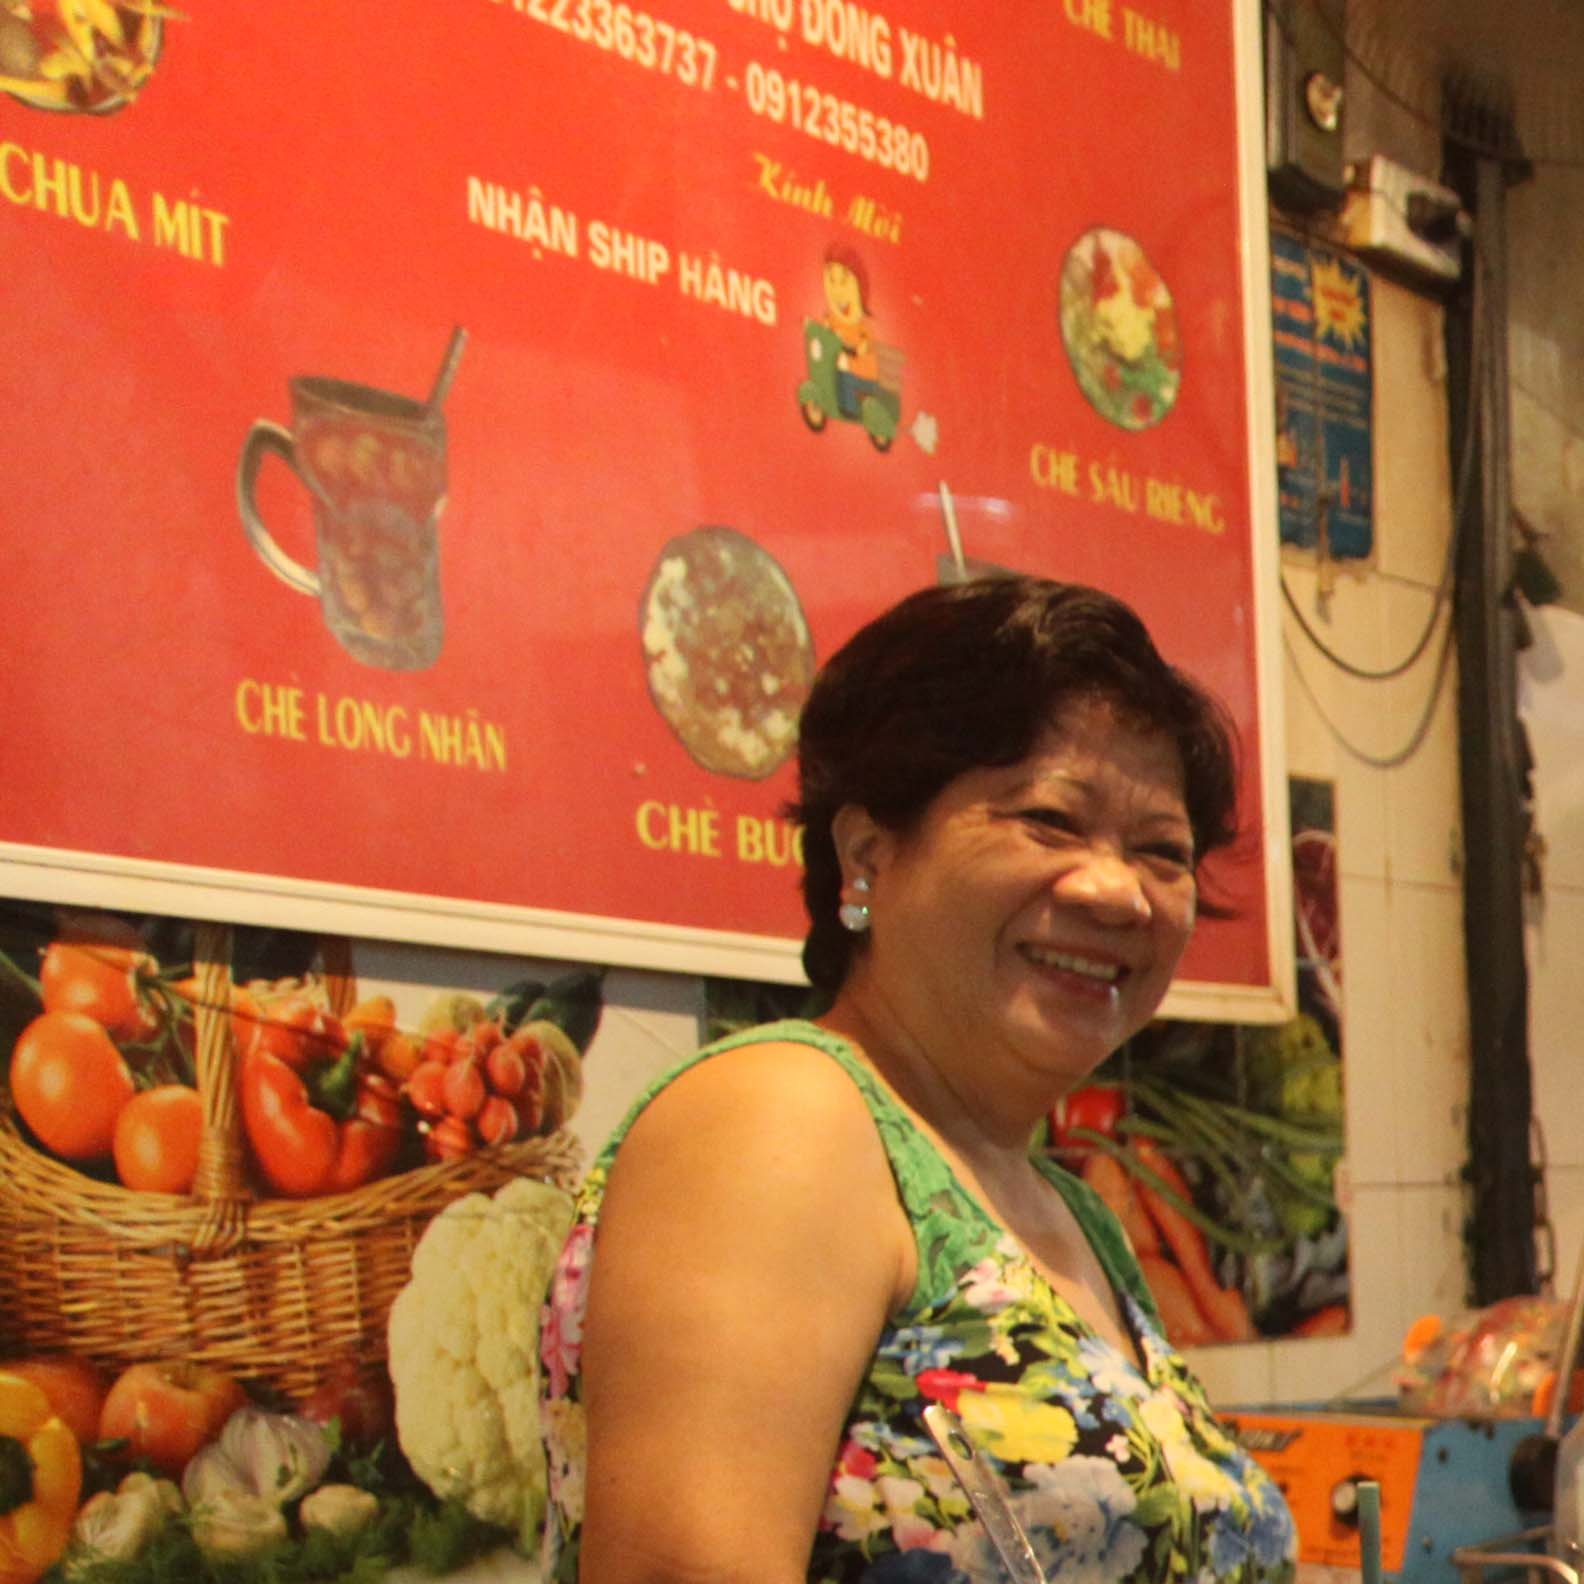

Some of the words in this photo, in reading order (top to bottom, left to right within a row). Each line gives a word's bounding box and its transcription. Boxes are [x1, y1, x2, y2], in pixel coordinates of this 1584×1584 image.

[490, 0, 718, 91] 223363737
[746, 61, 930, 183] 0912355380
[0, 141, 140, 241] CHUA
[587, 220, 671, 285] SHIP
[317, 692, 412, 758] LONG
[636, 793, 722, 858] CHÈ
